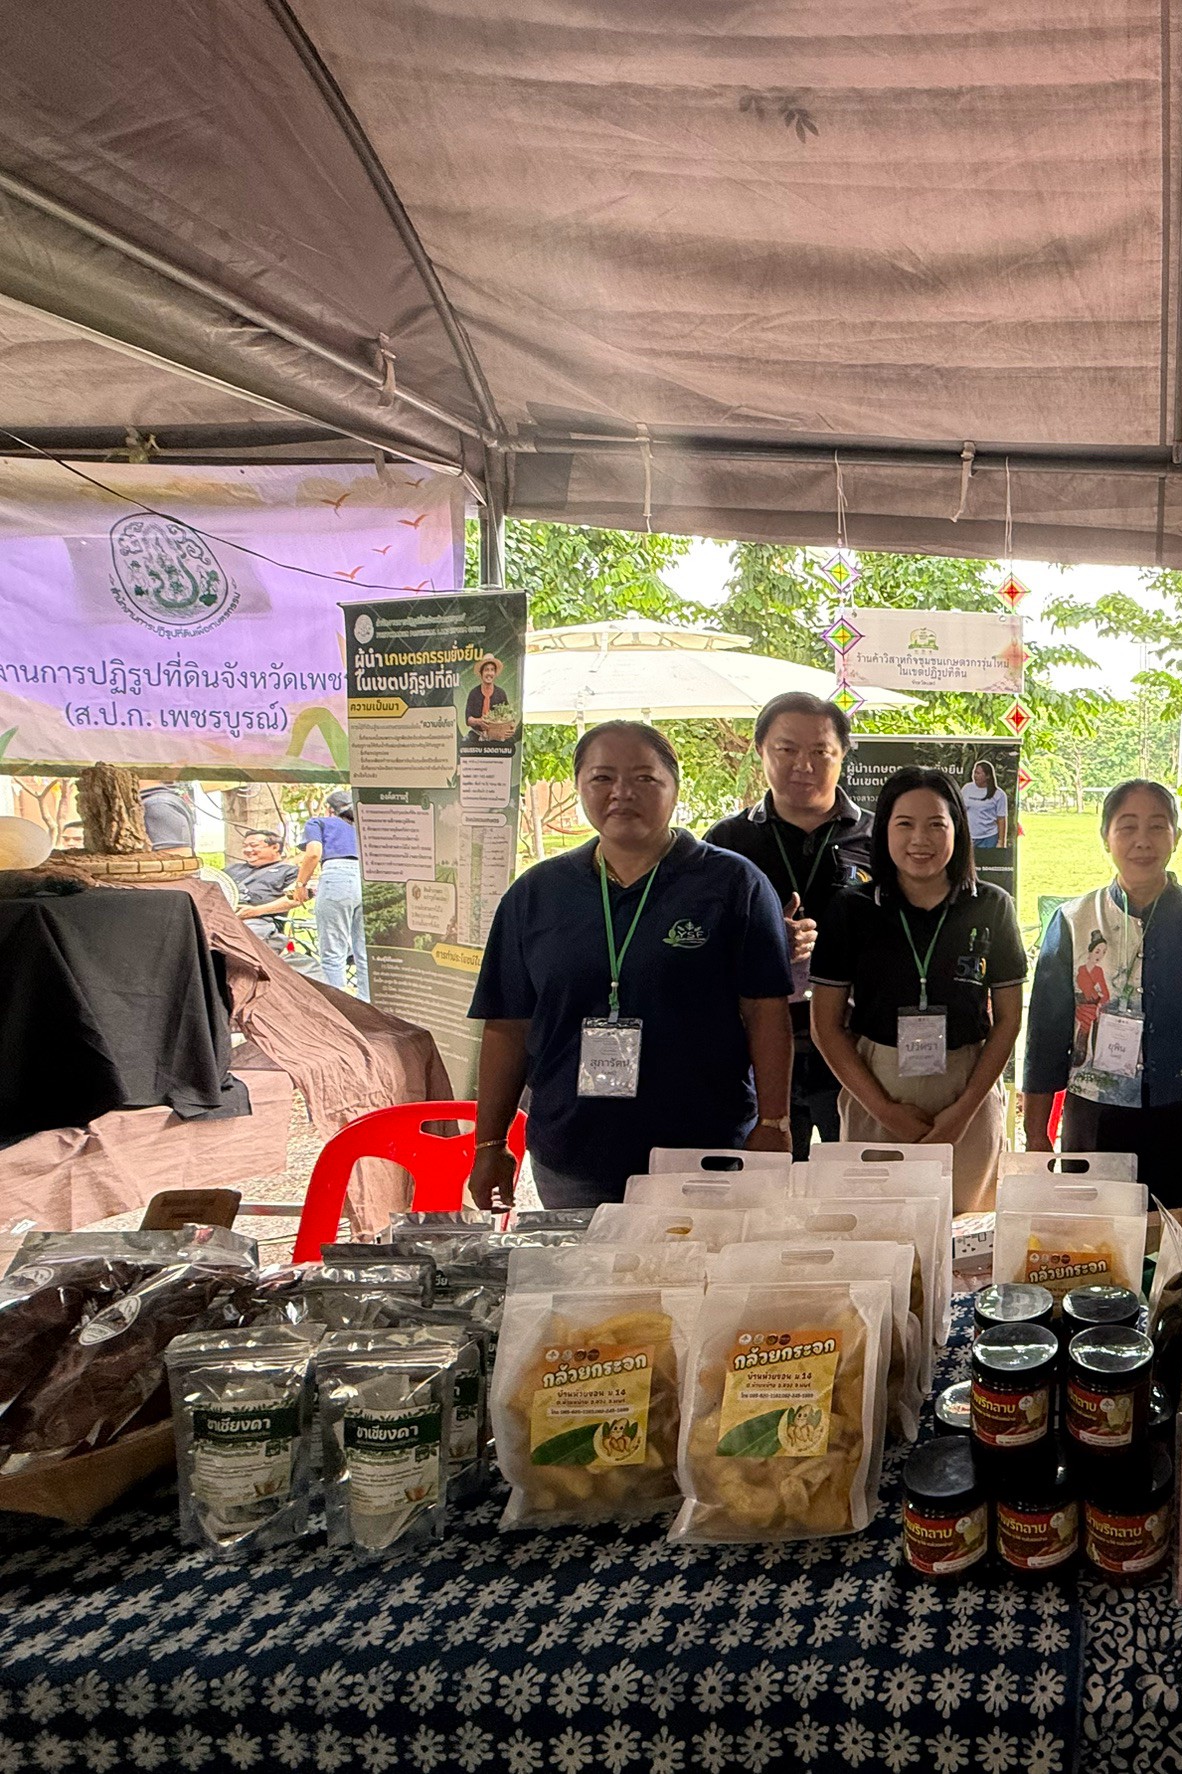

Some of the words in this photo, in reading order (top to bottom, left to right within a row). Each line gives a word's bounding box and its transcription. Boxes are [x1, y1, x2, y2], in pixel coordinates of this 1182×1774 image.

[0, 652, 347, 696] งานการปฏิรูปที่ดินจังหวัดเพช
[160, 700, 288, 738] เพชรบูรณ์)
[677, 930, 704, 938] YSF
[733, 1338, 836, 1371] กล้วยกระจก
[542, 1353, 648, 1389] กล้วยกระจก
[972, 1390, 1016, 1414] พริกลาบ
[905, 1517, 953, 1539] พริกลาบ
[999, 1511, 1047, 1534] พริกลาบ
